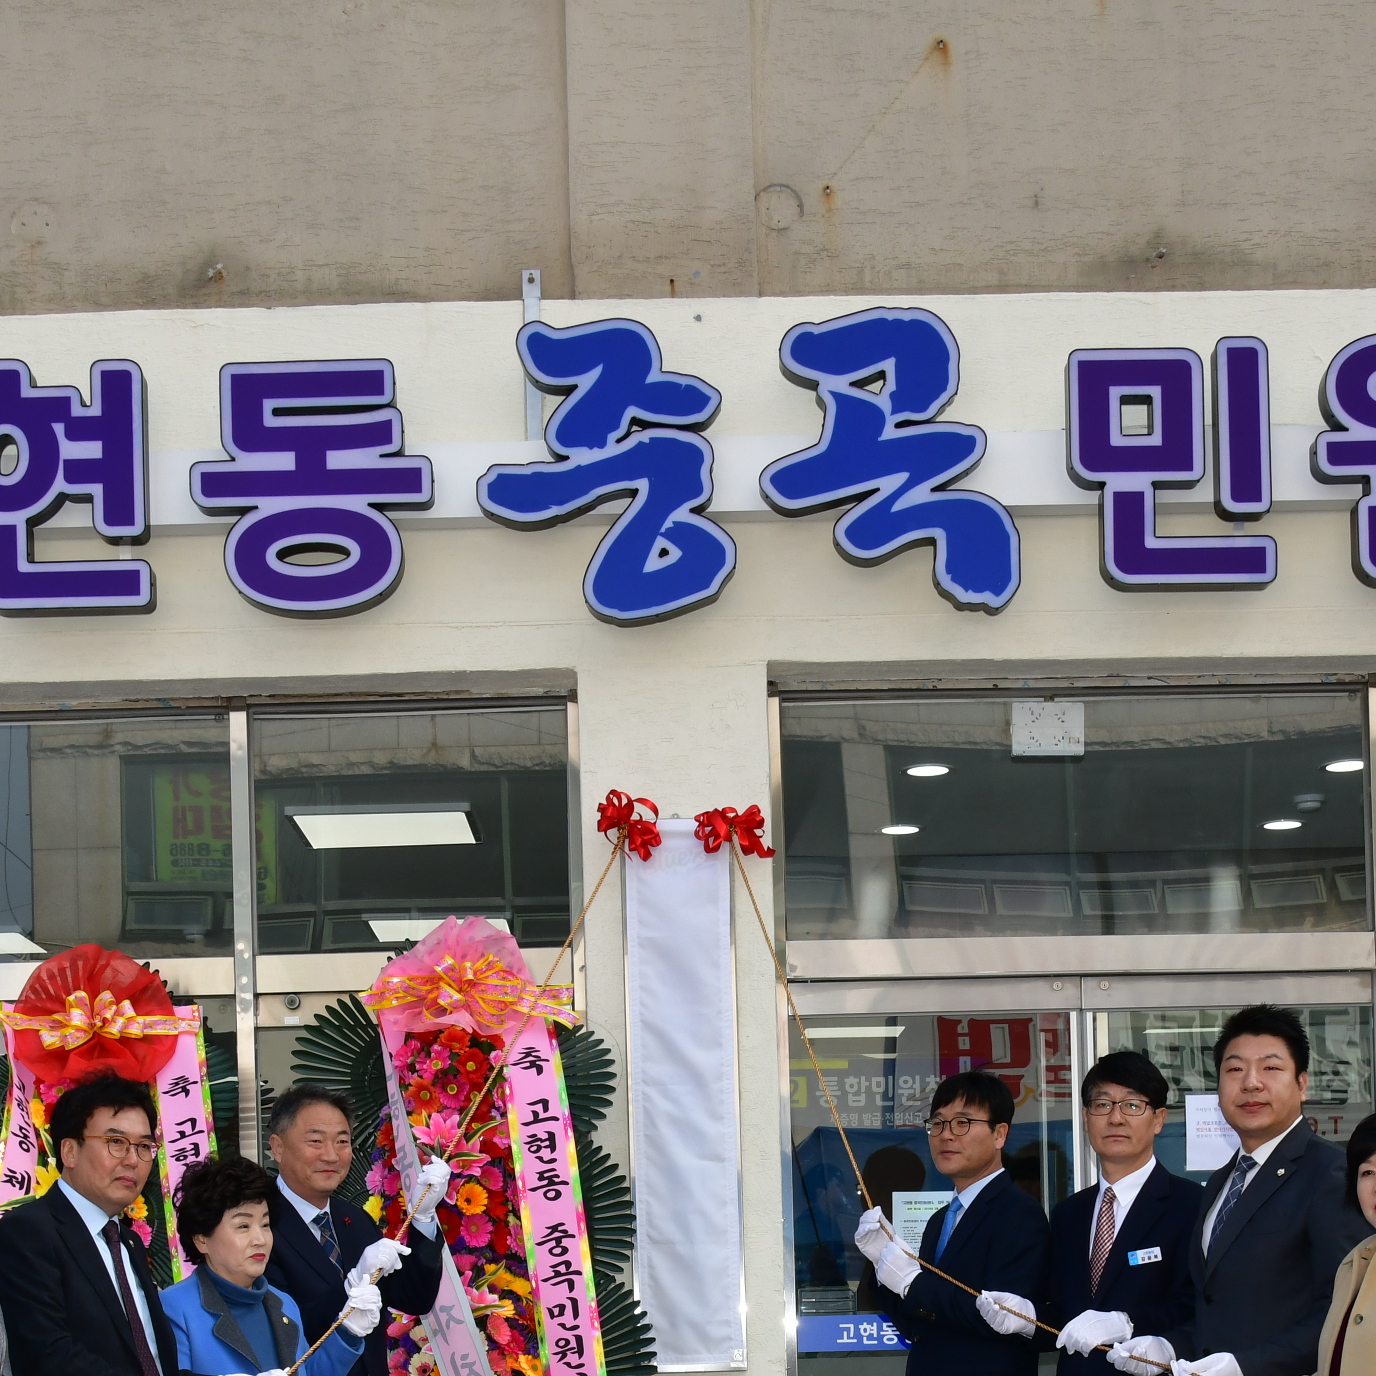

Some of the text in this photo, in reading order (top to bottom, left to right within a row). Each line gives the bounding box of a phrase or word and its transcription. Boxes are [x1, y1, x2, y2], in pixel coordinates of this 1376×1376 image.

[511, 1046, 550, 1076] 축
[161, 1074, 206, 1169] 축 고현
[520, 1098, 570, 1202] 고현동
[836, 1322, 911, 1345] 고현동
